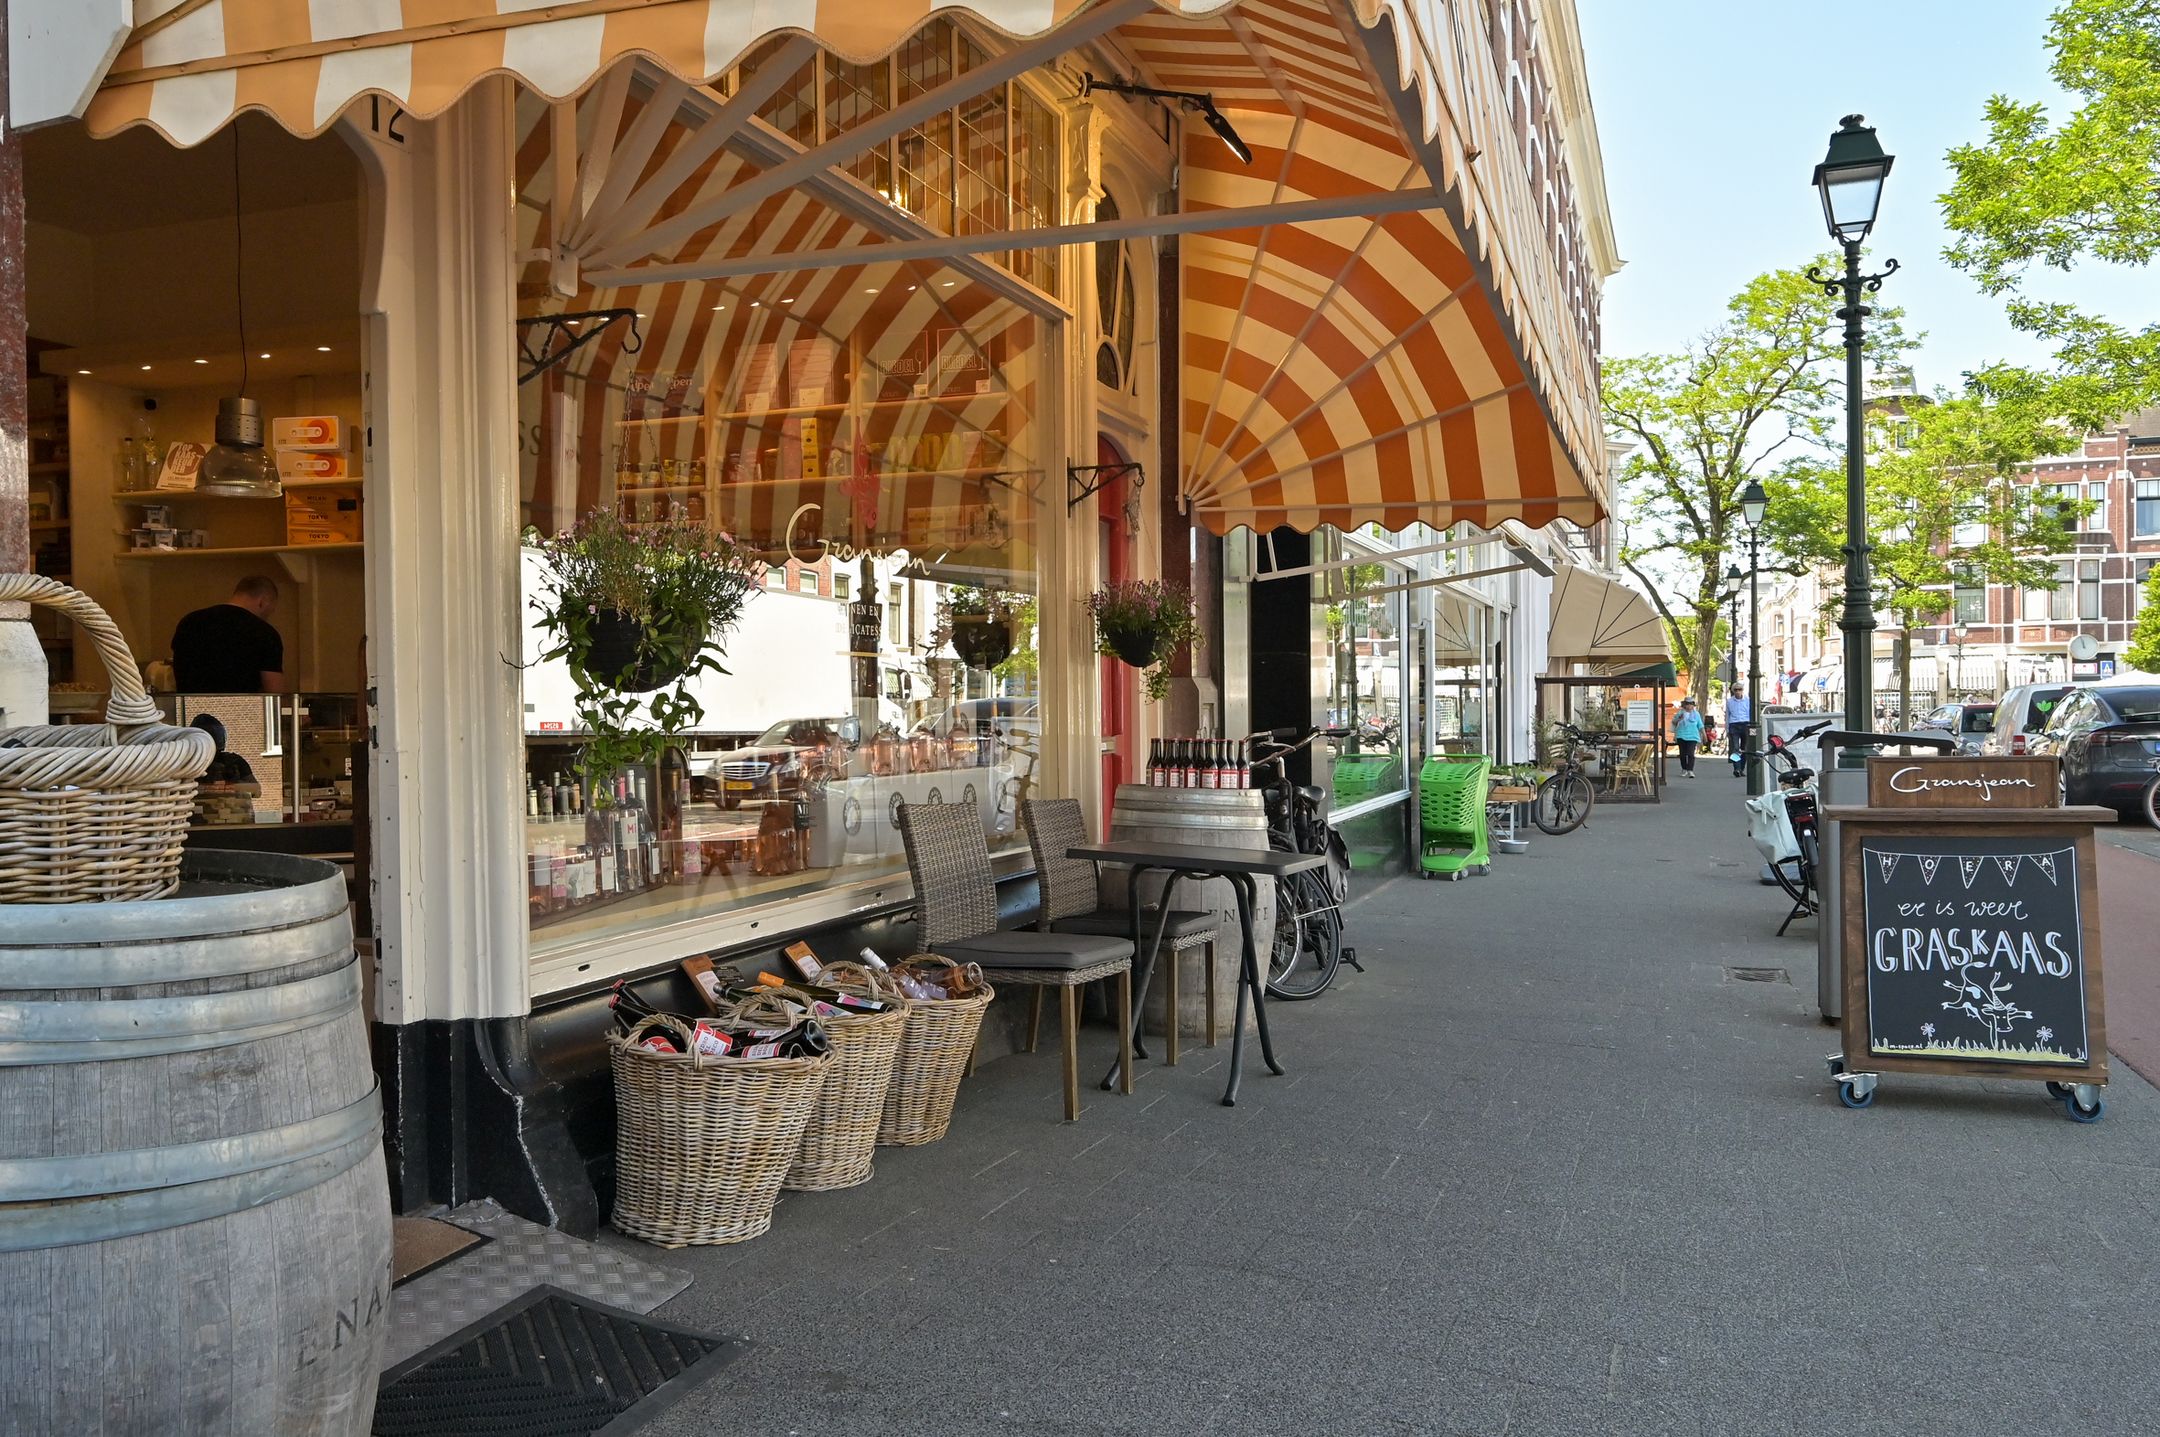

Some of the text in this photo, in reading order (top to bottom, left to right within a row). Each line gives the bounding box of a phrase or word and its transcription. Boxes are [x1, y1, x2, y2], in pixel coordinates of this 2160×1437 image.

[1889, 766, 2036, 801] Gransjean
[1898, 900, 2029, 920] er is weer
[1874, 927, 2072, 979] GRASKAAS
